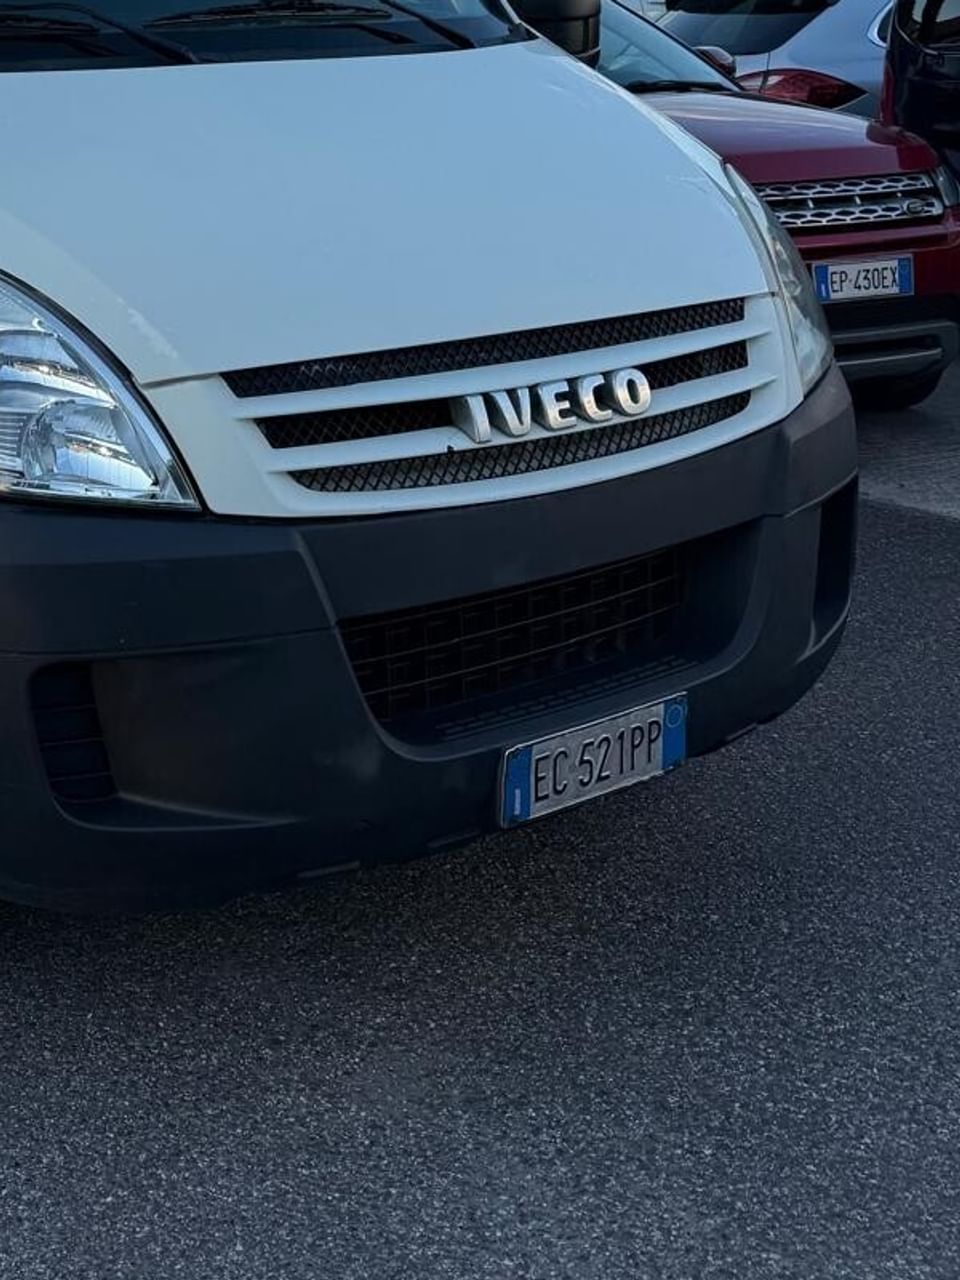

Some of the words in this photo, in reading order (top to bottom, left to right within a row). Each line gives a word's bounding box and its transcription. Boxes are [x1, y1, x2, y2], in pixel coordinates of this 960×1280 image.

[830, 270, 848, 293] EP
[853, 266, 898, 291] 430EX
[464, 367, 652, 444] IVECO
[534, 749, 568, 802] EC
[577, 719, 661, 787] 521PP
